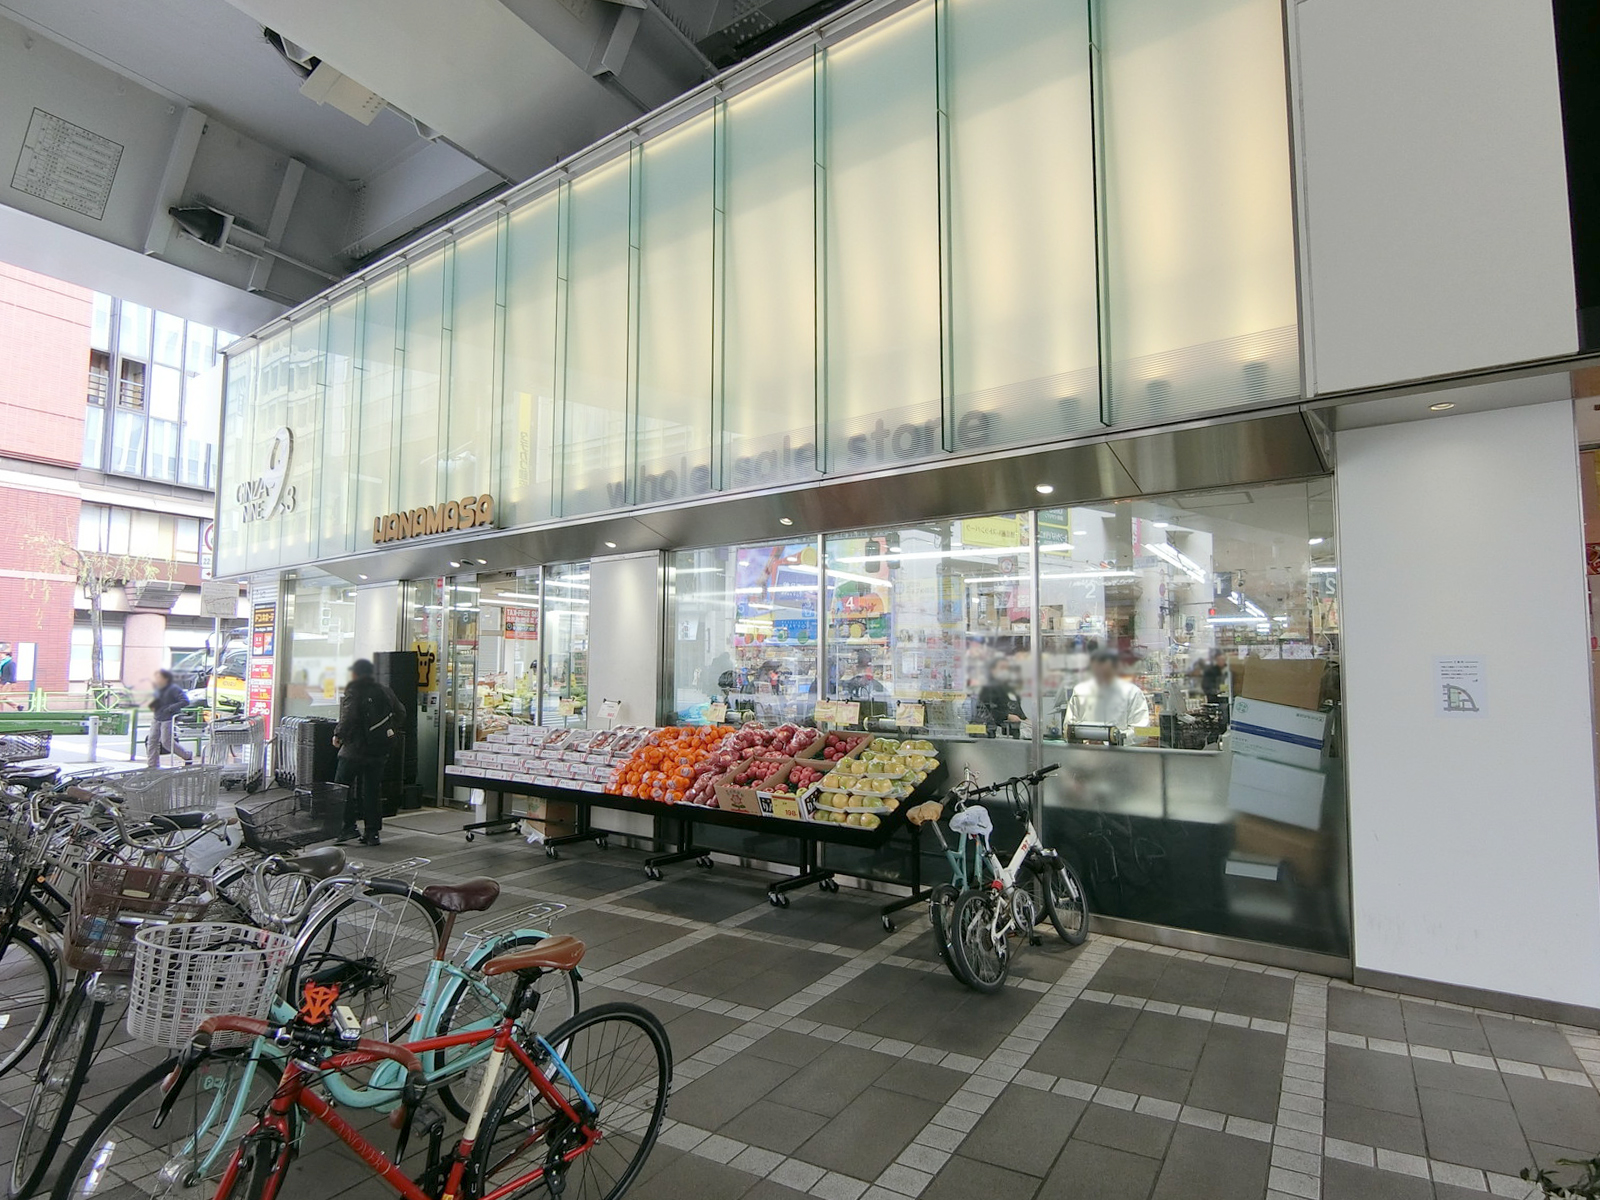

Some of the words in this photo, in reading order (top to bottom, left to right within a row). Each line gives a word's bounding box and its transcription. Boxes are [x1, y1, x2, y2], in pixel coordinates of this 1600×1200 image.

[847, 409, 988, 466] store
[236, 477, 270, 505] GINZA
[372, 493, 494, 545] HANAMASA
[845, 596, 855, 610] 4
[1085, 580, 1097, 599] 2
[326, 1115, 383, 1170] CANOVER
